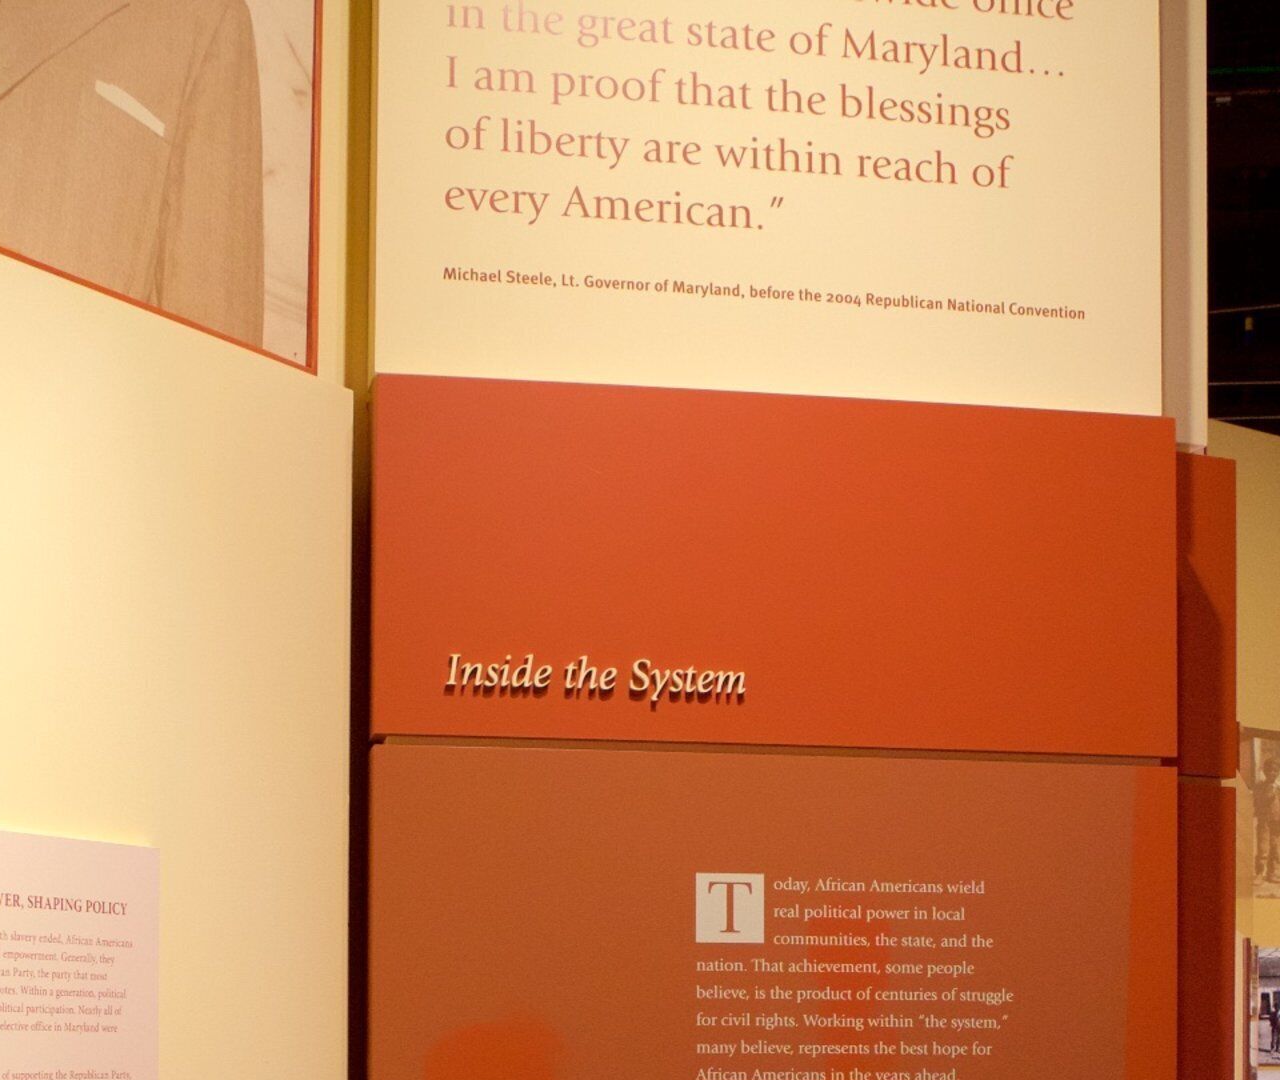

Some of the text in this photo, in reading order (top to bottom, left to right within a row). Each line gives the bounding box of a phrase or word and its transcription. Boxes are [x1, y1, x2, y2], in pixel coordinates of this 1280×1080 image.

[445, 3, 484, 29] in
[503, 0, 562, 35] the
[577, 15, 673, 48] great
[687, 21, 775, 53] state
[789, 22, 832, 56] of
[445, 56, 1010, 139] I am proof that the blessings
[445, 115, 1014, 189] of liberty are within reach of
[444, 186, 549, 225] every
[442, 266, 1085, 320] Michael Steele, Lt. Governor of Maryland, before the 2004 Republican National Convention
[445, 653, 746, 702] Inside the System
[814, 876, 865, 892] African
[869, 879, 943, 894] Americans
[946, 880, 984, 894] wield
[27, 895, 82, 912] SHAPING
[86, 899, 126, 915] POLICY
[773, 903, 965, 922] real political power in local
[10, 930, 36, 945] slavery
[65, 934, 93, 946] African
[95, 937, 132, 948] Americans
[773, 932, 993, 948] communities, the state, and the
[99, 953, 114, 966] they
[696, 958, 974, 978] nation. That achievement, some people
[37, 968, 49, 978] the
[51, 971, 70, 982] party
[73, 969, 87, 980] that
[695, 984, 1013, 1005] believe, is the product of centuries of struggle
[696, 1011, 717, 1026] for
[720, 1012, 750, 1026] civil
[755, 1012, 798, 1030] rights.
[802, 1013, 864, 1031] Working
[866, 1013, 913, 1028] within
[696, 1039, 992, 1058] many believe, represents the best hope for
[1, 1070, 9, 1080] of
[55, 1069, 67, 1080] the
[695, 1066, 747, 1080] African
